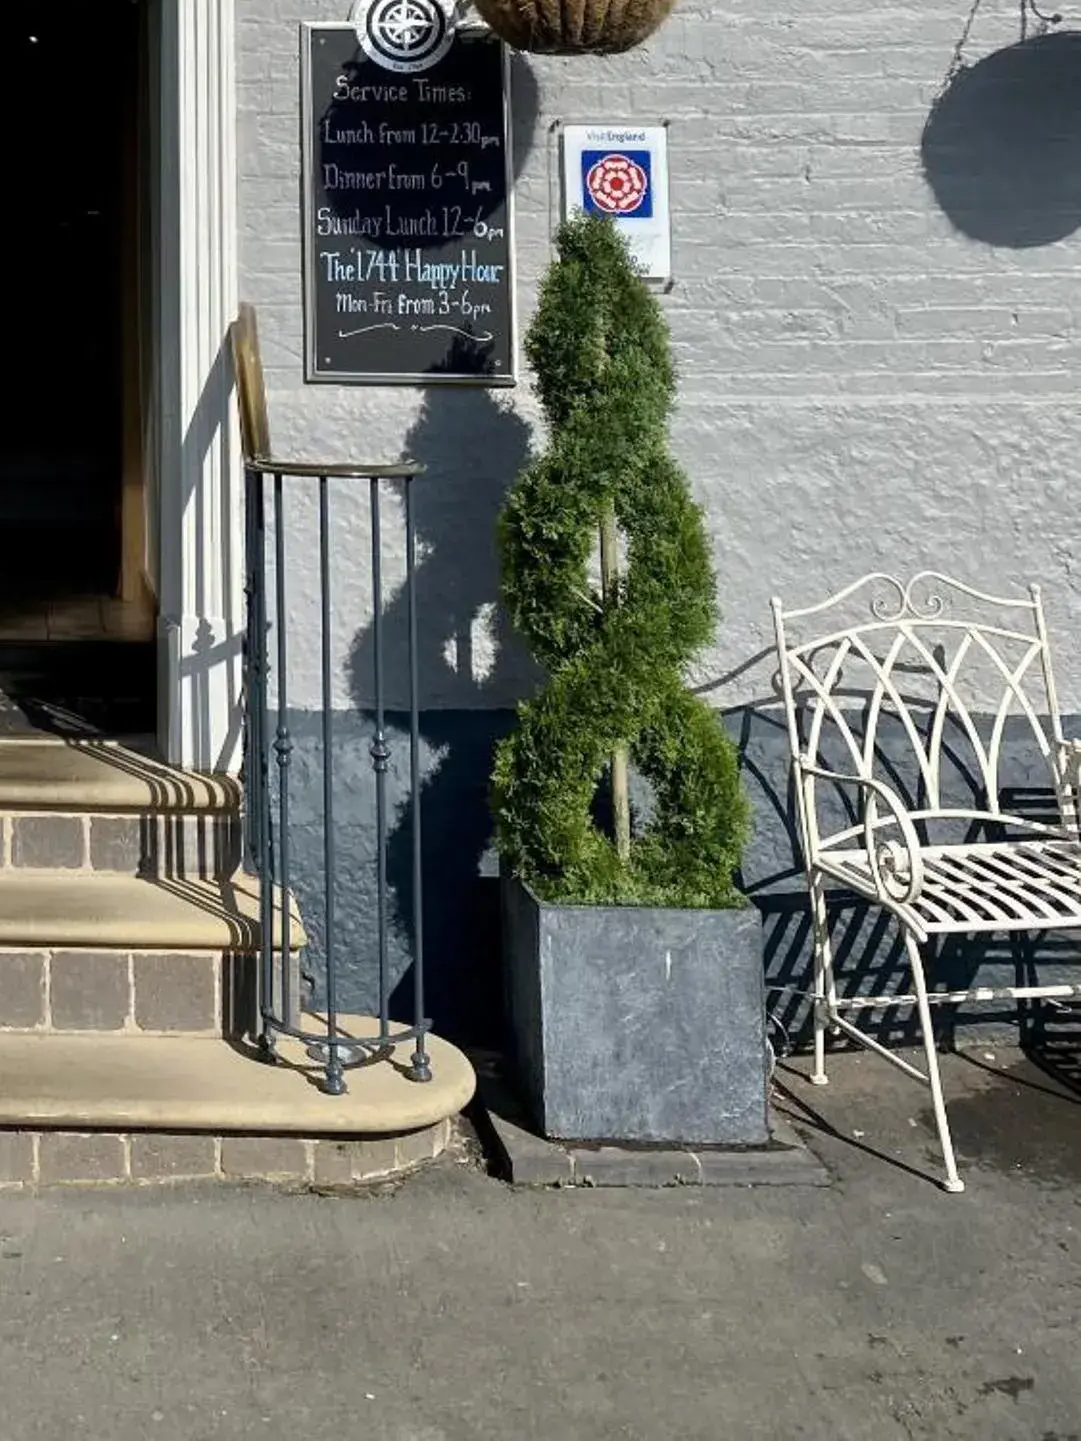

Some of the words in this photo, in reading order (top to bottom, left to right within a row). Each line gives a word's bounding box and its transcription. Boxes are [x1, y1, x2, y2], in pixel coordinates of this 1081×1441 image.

[333, 75, 408, 101] Service
[412, 78, 472, 103] Times:
[324, 120, 374, 145] Lunch
[379, 122, 415, 145] from
[323, 162, 386, 190] Dinner
[387, 162, 425, 190] from
[317, 207, 382, 237] Sunday
[385, 205, 438, 236] Lunch
[320, 251, 354, 282] The
[405, 248, 460, 289] Happy
[461, 249, 504, 283] Hour
[398, 294, 434, 314] from
